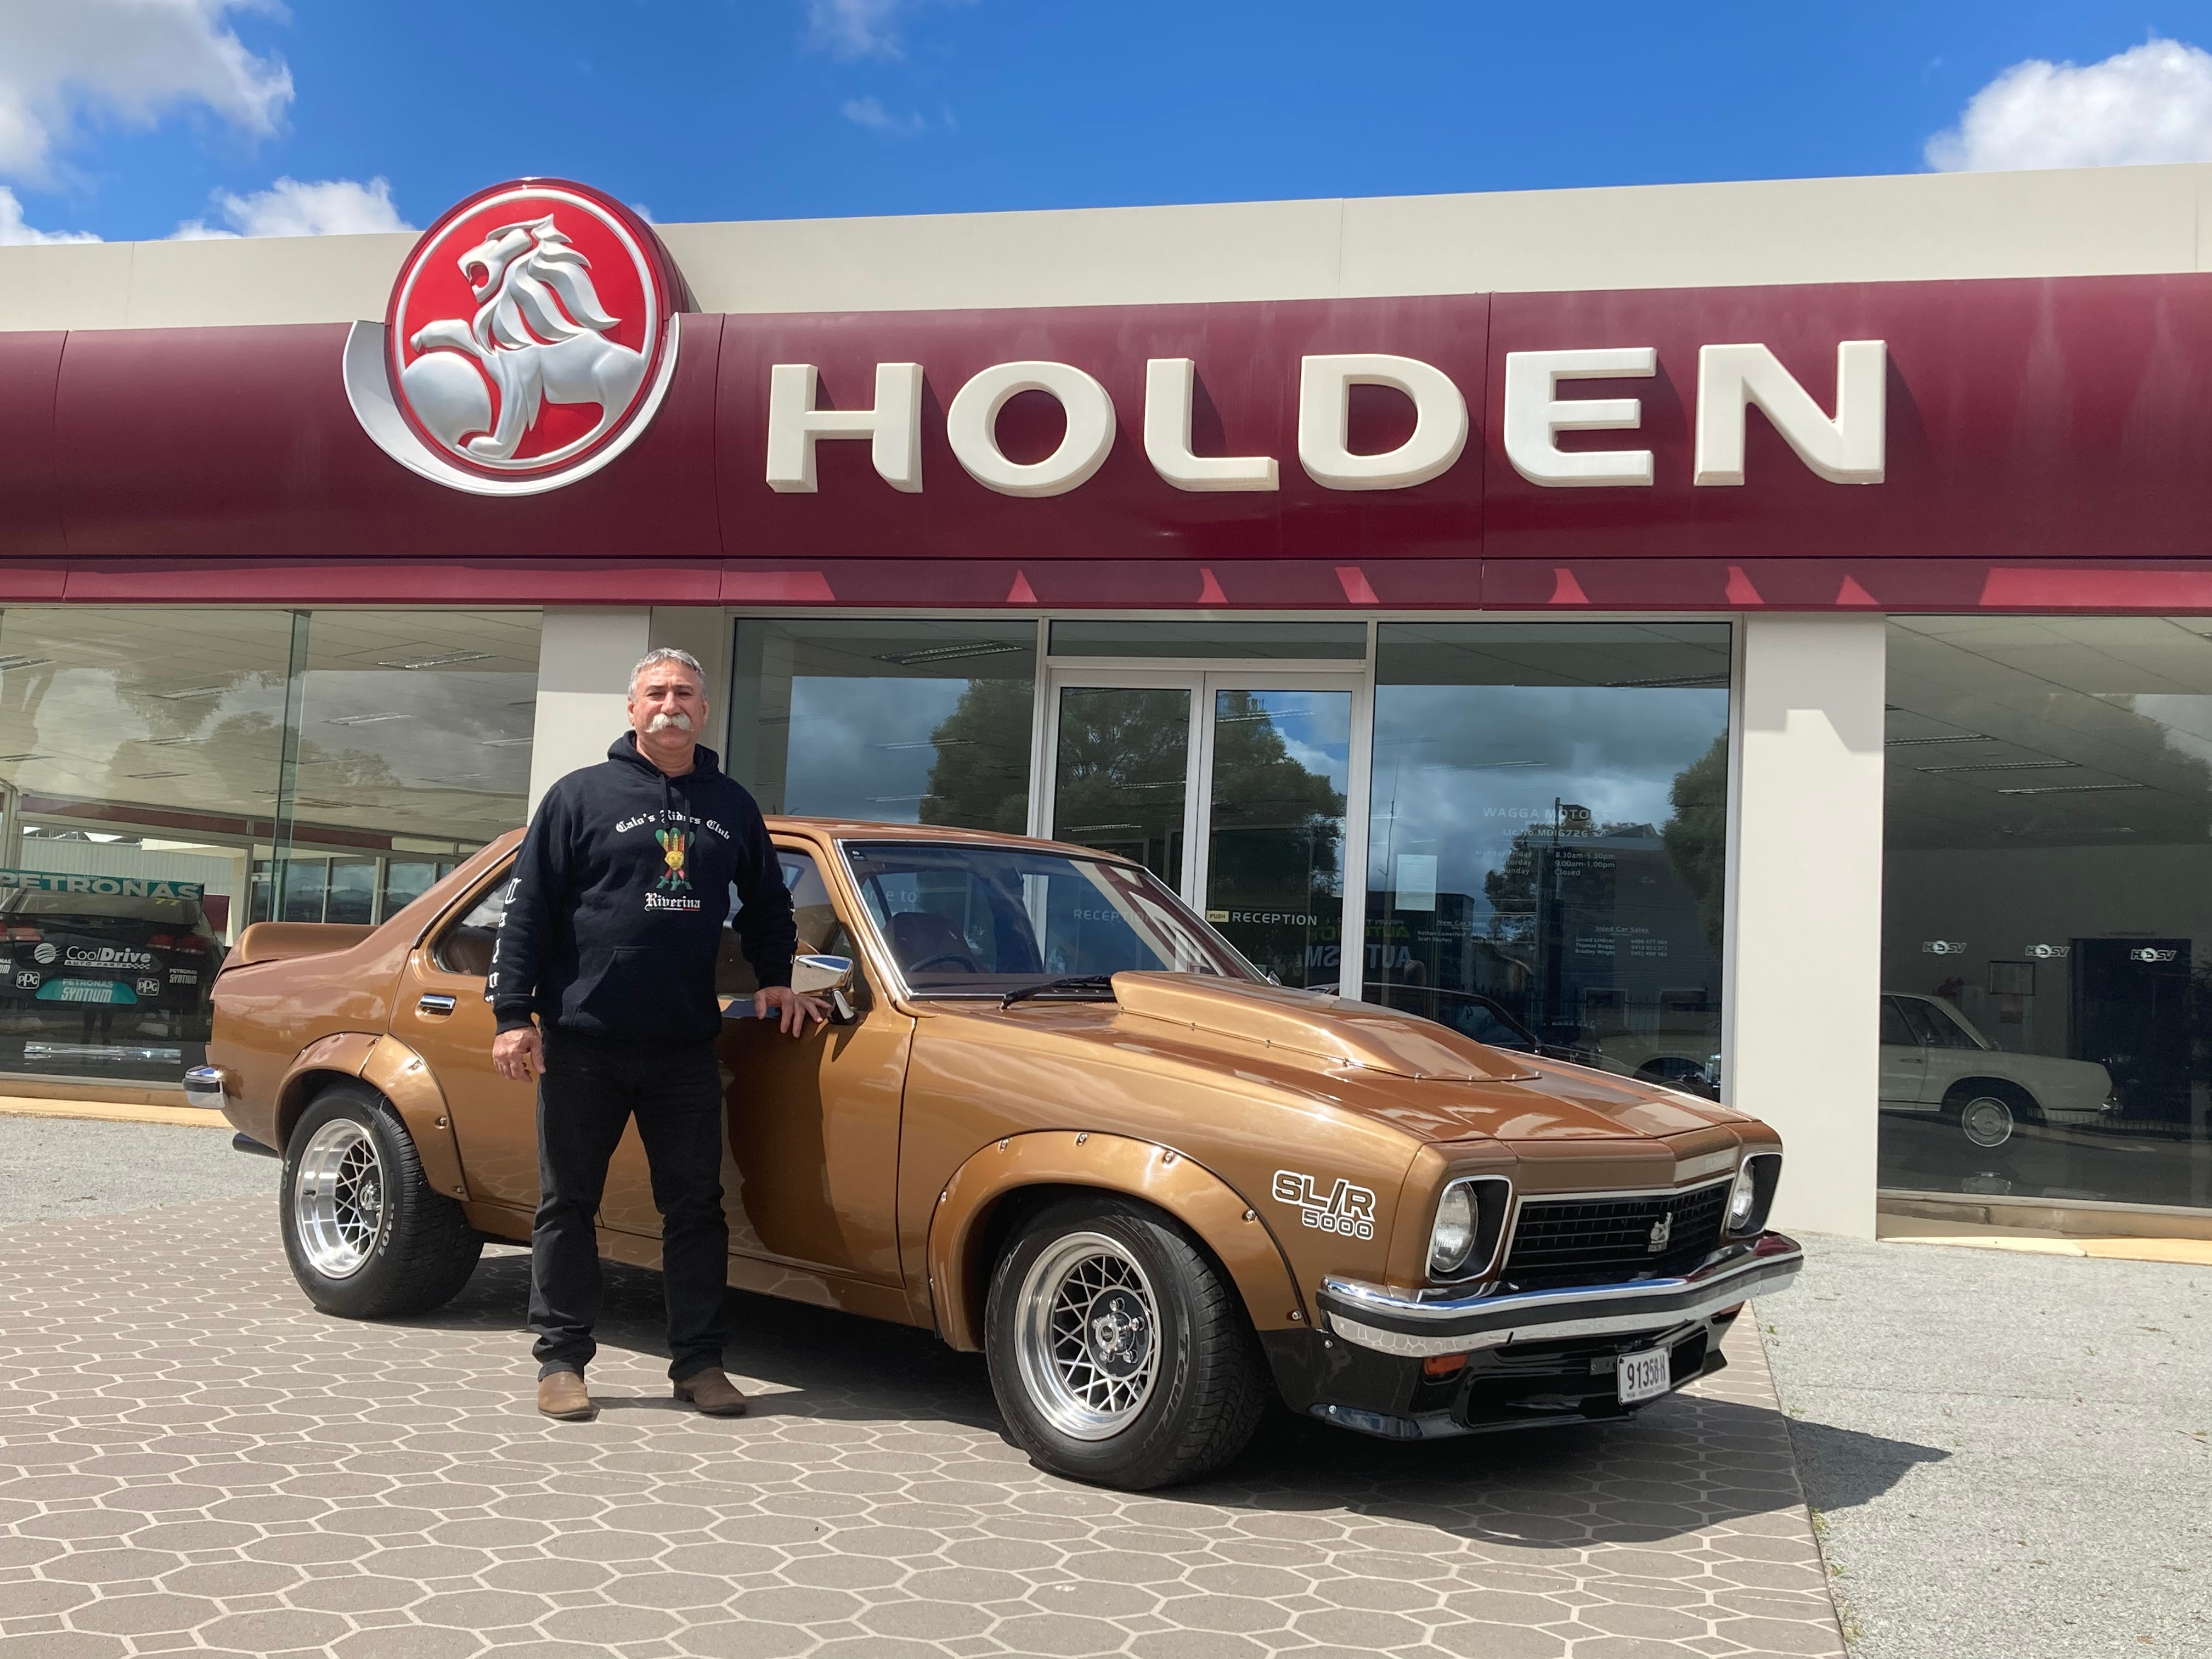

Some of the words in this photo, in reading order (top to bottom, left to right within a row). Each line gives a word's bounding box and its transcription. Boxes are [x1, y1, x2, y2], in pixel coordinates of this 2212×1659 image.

[766, 340, 1887, 498] HOLDEN
[1483, 807, 1539, 818] WAGGA
[1545, 808, 1611, 820] MOTORS
[616, 812, 656, 832] Calo's
[659, 809, 701, 825] Ridrs
[706, 819, 731, 839] Club
[1501, 867, 1531, 876] Sunday
[0, 871, 199, 900] PETRONAS
[644, 892, 701, 911] Riverina
[1232, 911, 1317, 926] RECEPTION
[66, 945, 151, 963] CoolDrive
[18, 973, 38, 987] PPG
[63, 978, 114, 988] PETRONAS
[138, 980, 158, 993] PPG
[60, 988, 113, 1003] SYNTIUM
[1272, 1169, 1376, 1222] SL/R
[1301, 1208, 1374, 1240] 5000
